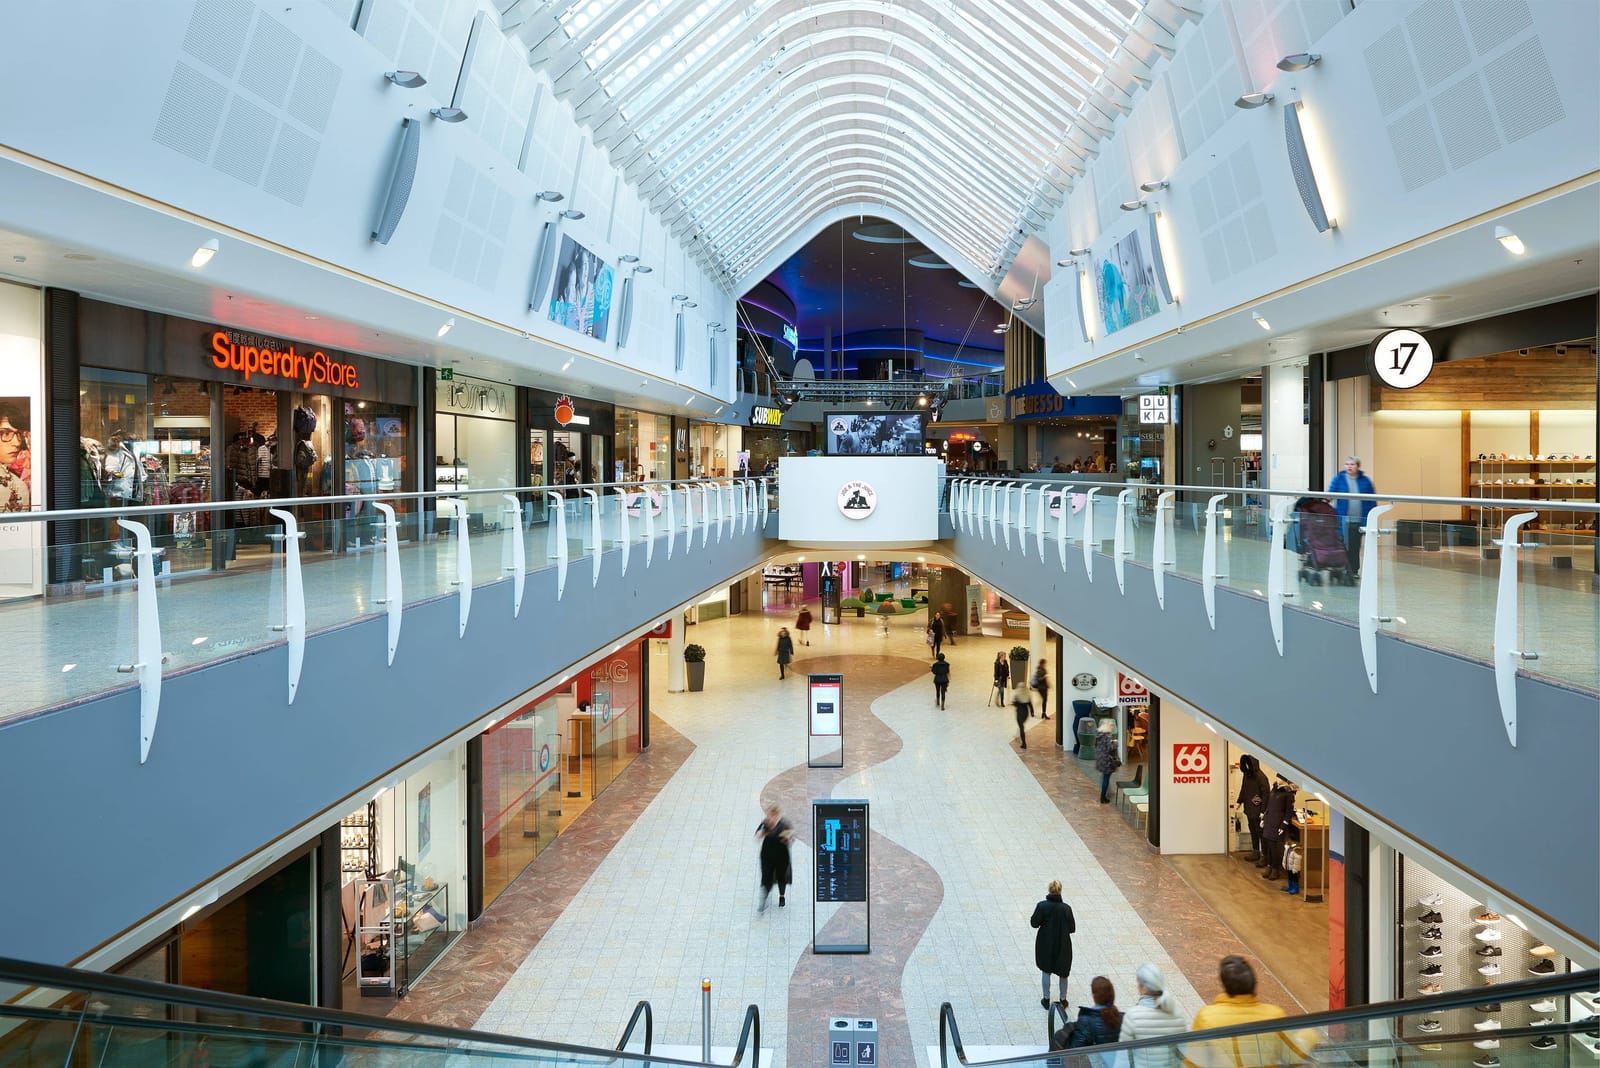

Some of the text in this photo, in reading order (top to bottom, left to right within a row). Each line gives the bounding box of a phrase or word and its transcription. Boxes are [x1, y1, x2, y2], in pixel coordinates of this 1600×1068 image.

[1389, 343, 1419, 375] 17
[752, 406, 783, 425] SUBWAY
[591, 659, 629, 683] 4G
[1173, 776, 1210, 784] NORTH
